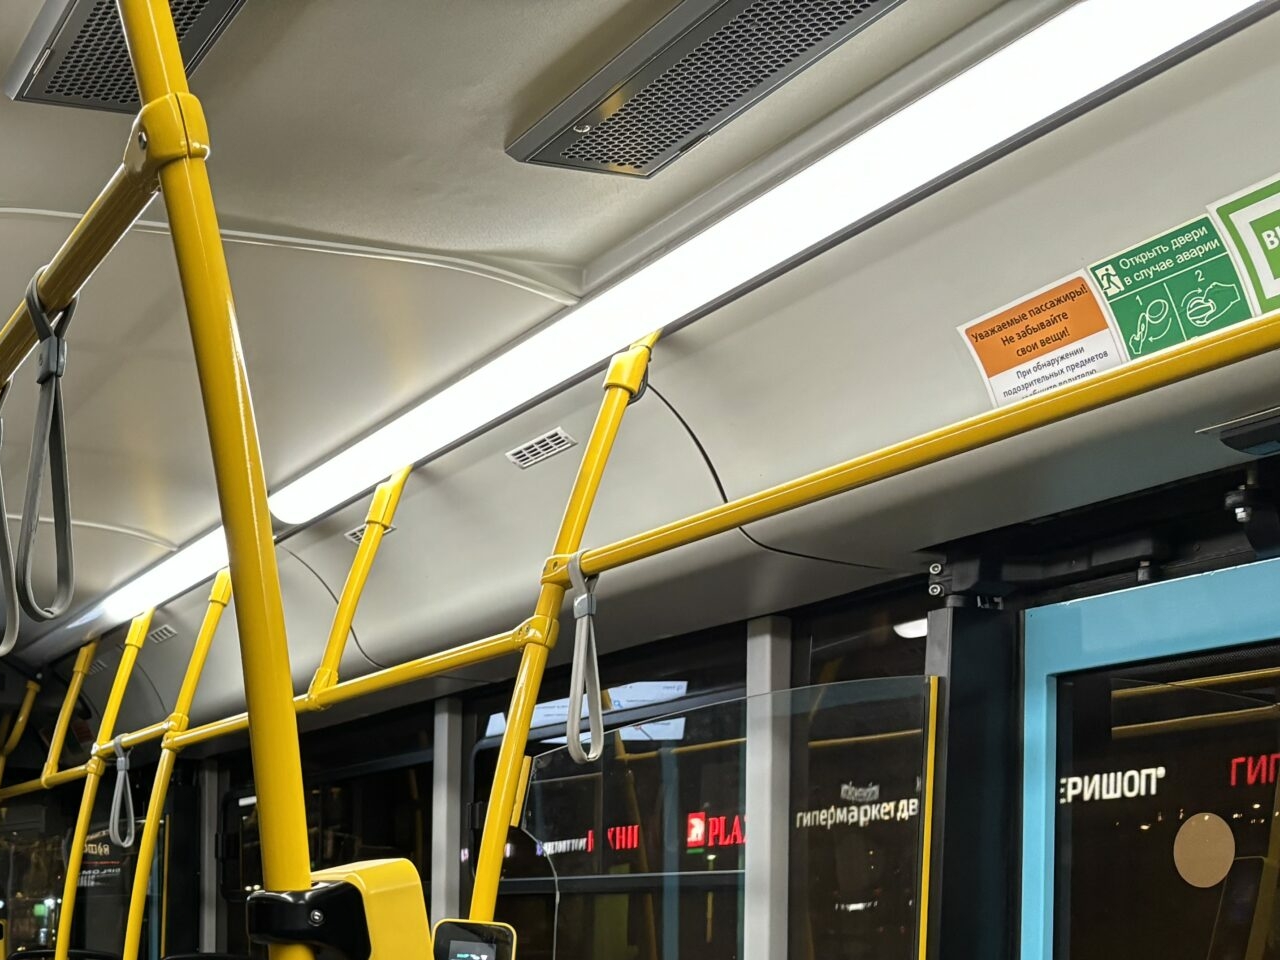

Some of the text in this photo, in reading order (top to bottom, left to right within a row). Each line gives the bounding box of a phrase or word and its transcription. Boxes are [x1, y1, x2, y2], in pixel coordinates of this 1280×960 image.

[1119, 225, 1208, 269] Открыть двери
[1262, 226, 1280, 250] В
[1124, 238, 1220, 286] в случае аварии
[1194, 269, 1205, 282] 2
[971, 284, 1088, 343] Уважаемые пассажиры!
[1135, 295, 1143, 306] 1
[1001, 310, 1069, 347] Не забывайте
[1016, 326, 1071, 357] свои вещи!
[1003, 369, 1065, 398] подозрительных
[1066, 350, 1109, 374] предметов
[1016, 346, 1085, 380] При обнаружении
[708, 814, 747, 847] PLA
